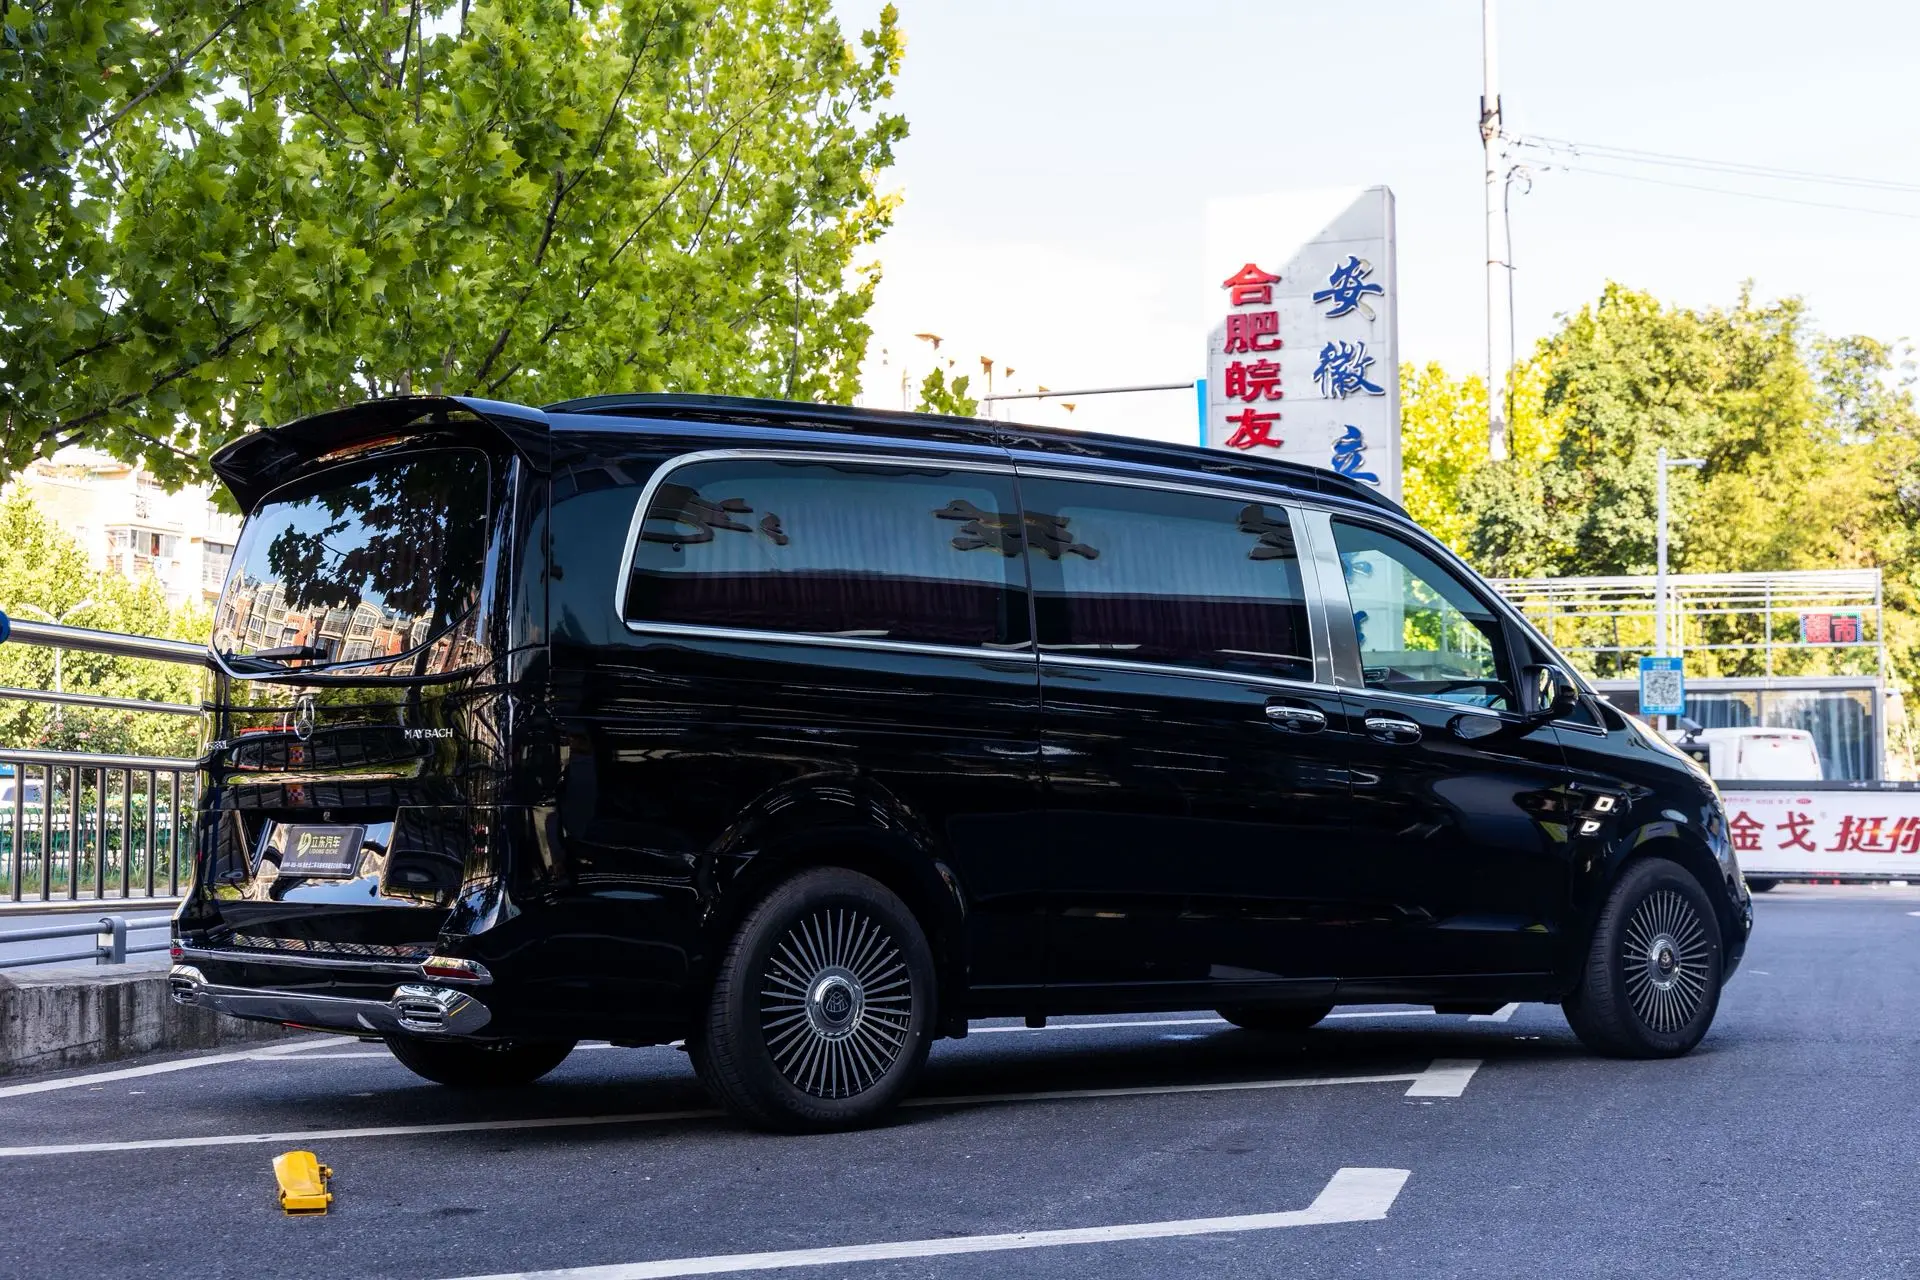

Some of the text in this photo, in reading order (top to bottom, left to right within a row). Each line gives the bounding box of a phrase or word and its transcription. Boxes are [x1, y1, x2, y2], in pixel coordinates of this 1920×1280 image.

[1222, 262, 1283, 449] 合肥皖友
[404, 728, 454, 739] MAYBACH
[310, 835, 341, 849] 立东汽车
[1729, 811, 1816, 853] 金戈
